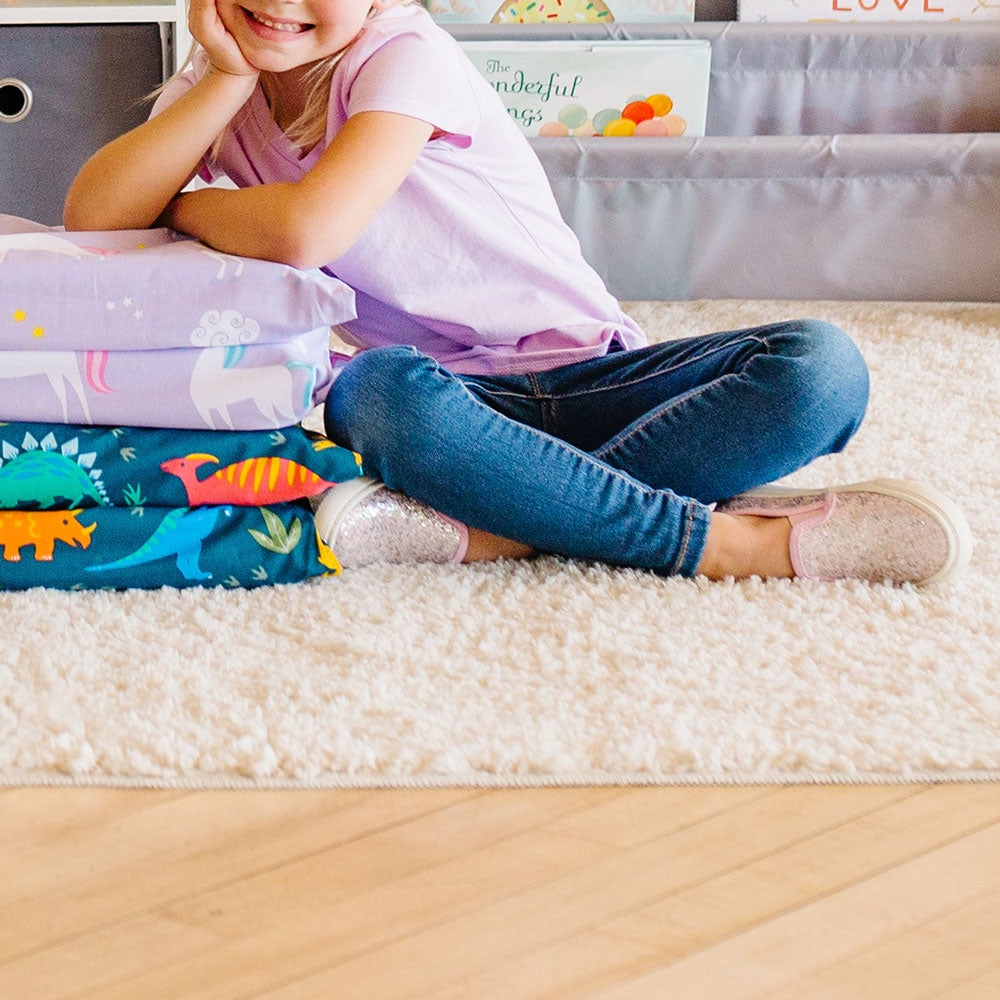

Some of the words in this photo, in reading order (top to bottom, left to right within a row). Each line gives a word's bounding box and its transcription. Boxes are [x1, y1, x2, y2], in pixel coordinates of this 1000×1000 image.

[486, 59, 511, 74] The
[490, 70, 583, 102] nderful
[507, 107, 543, 128] ngs
